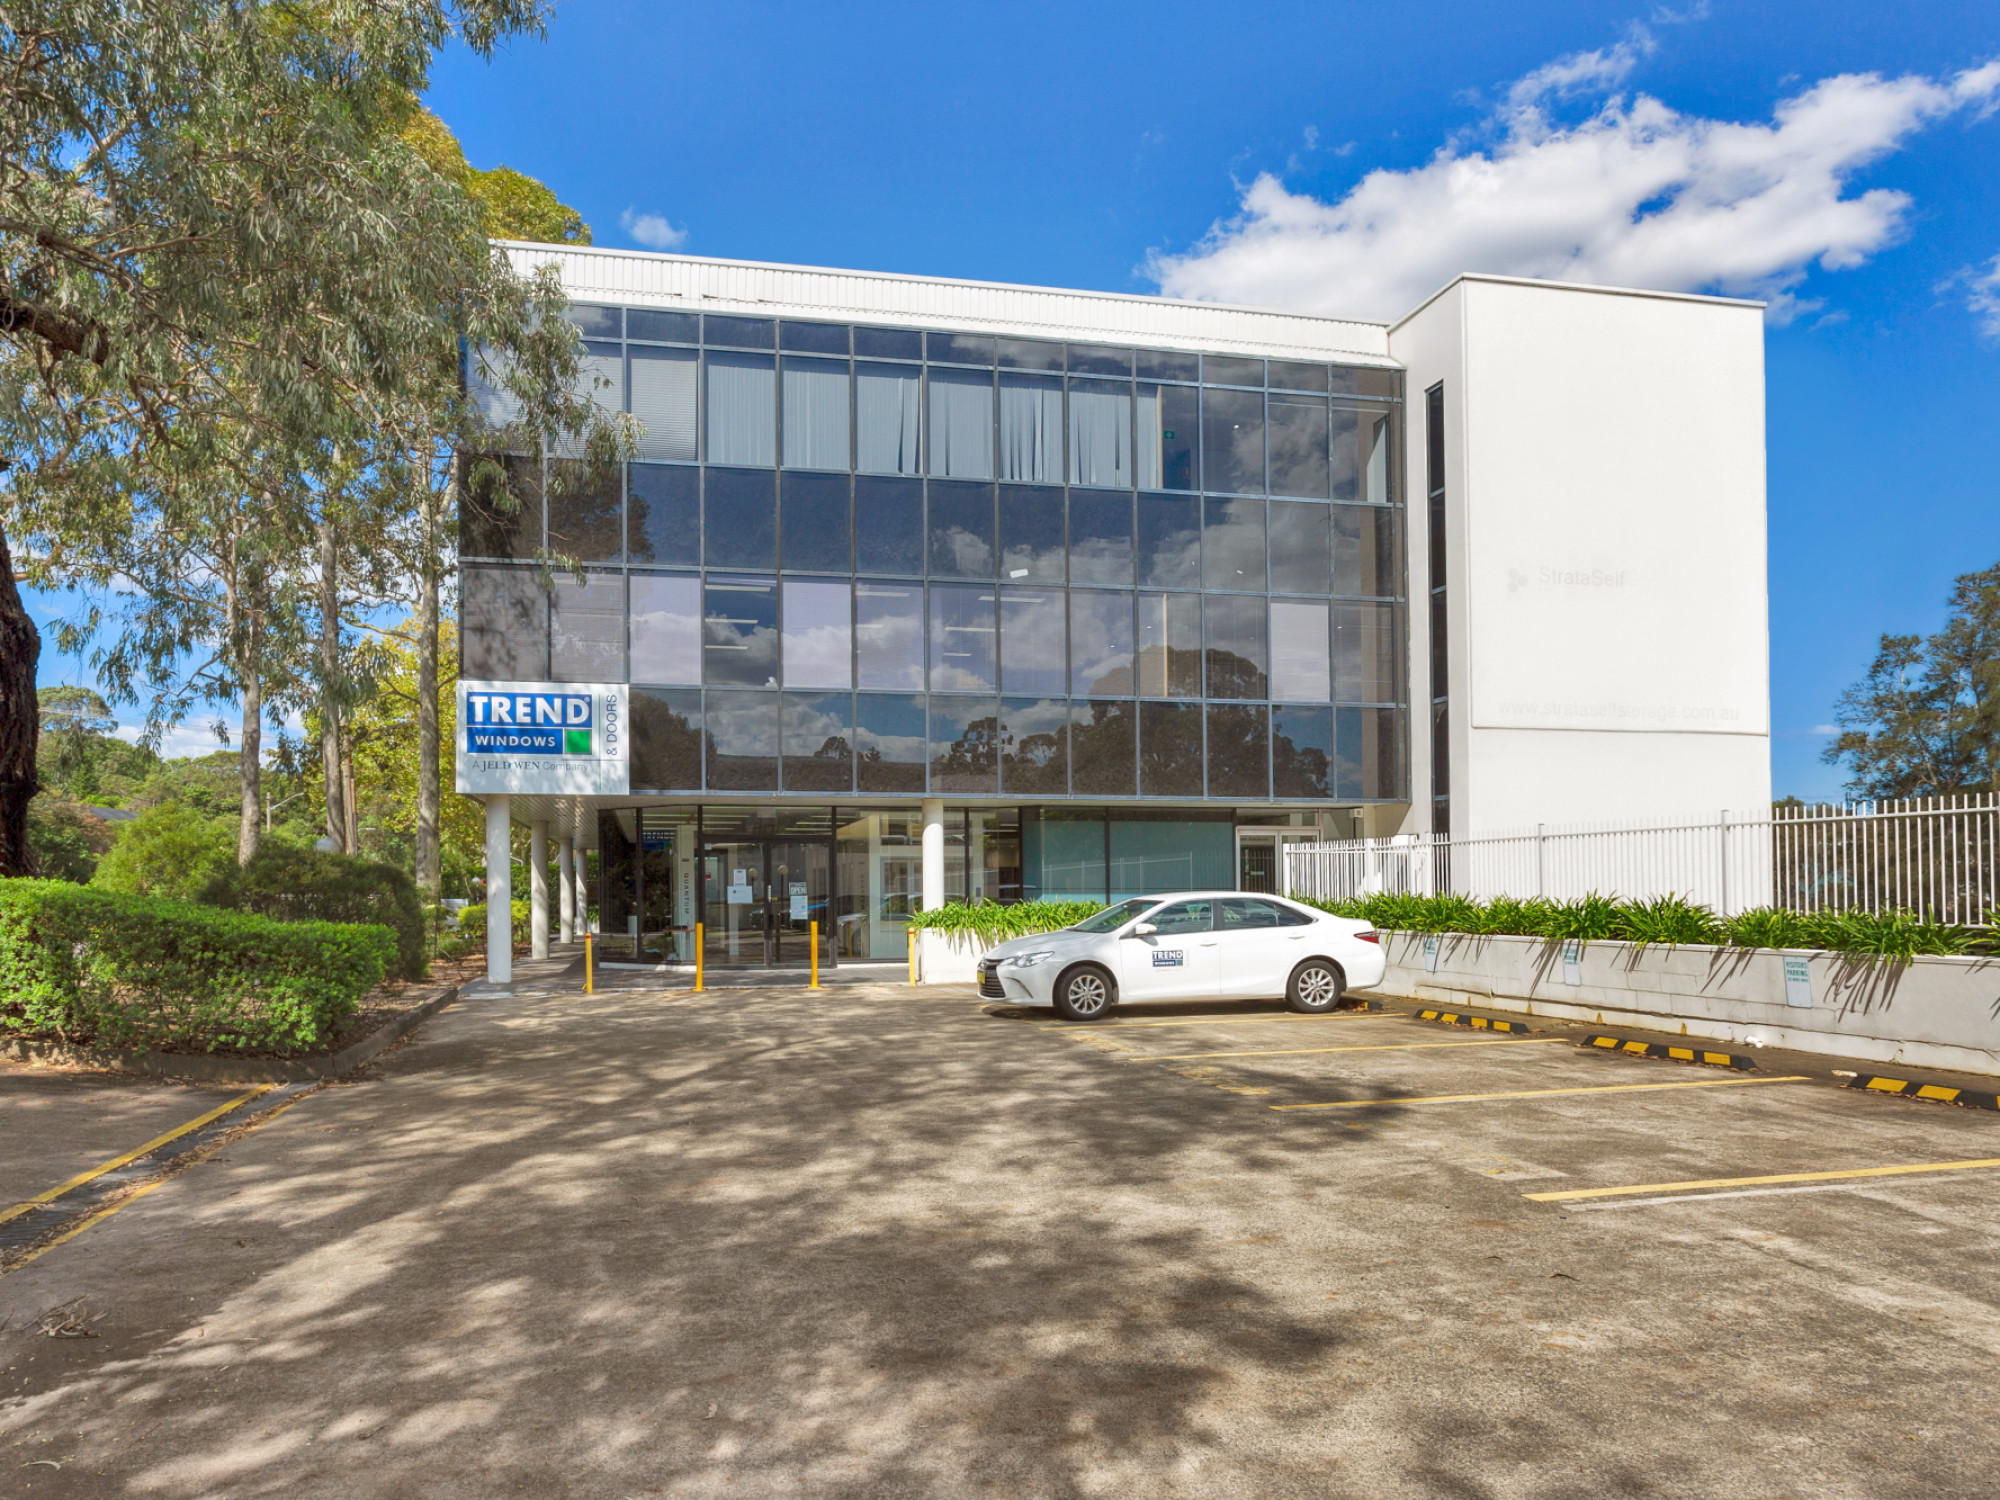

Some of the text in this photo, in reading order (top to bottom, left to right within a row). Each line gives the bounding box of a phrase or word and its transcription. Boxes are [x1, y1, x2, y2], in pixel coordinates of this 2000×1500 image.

[1539, 566, 1625, 588] StrataSelf
[469, 695, 590, 725] TREND
[606, 694, 618, 744] DOORS
[475, 734, 556, 747] WINDOWS
[472, 760, 480, 769] A
[543, 761, 589, 773] Company
[1153, 951, 1183, 959] TREND
